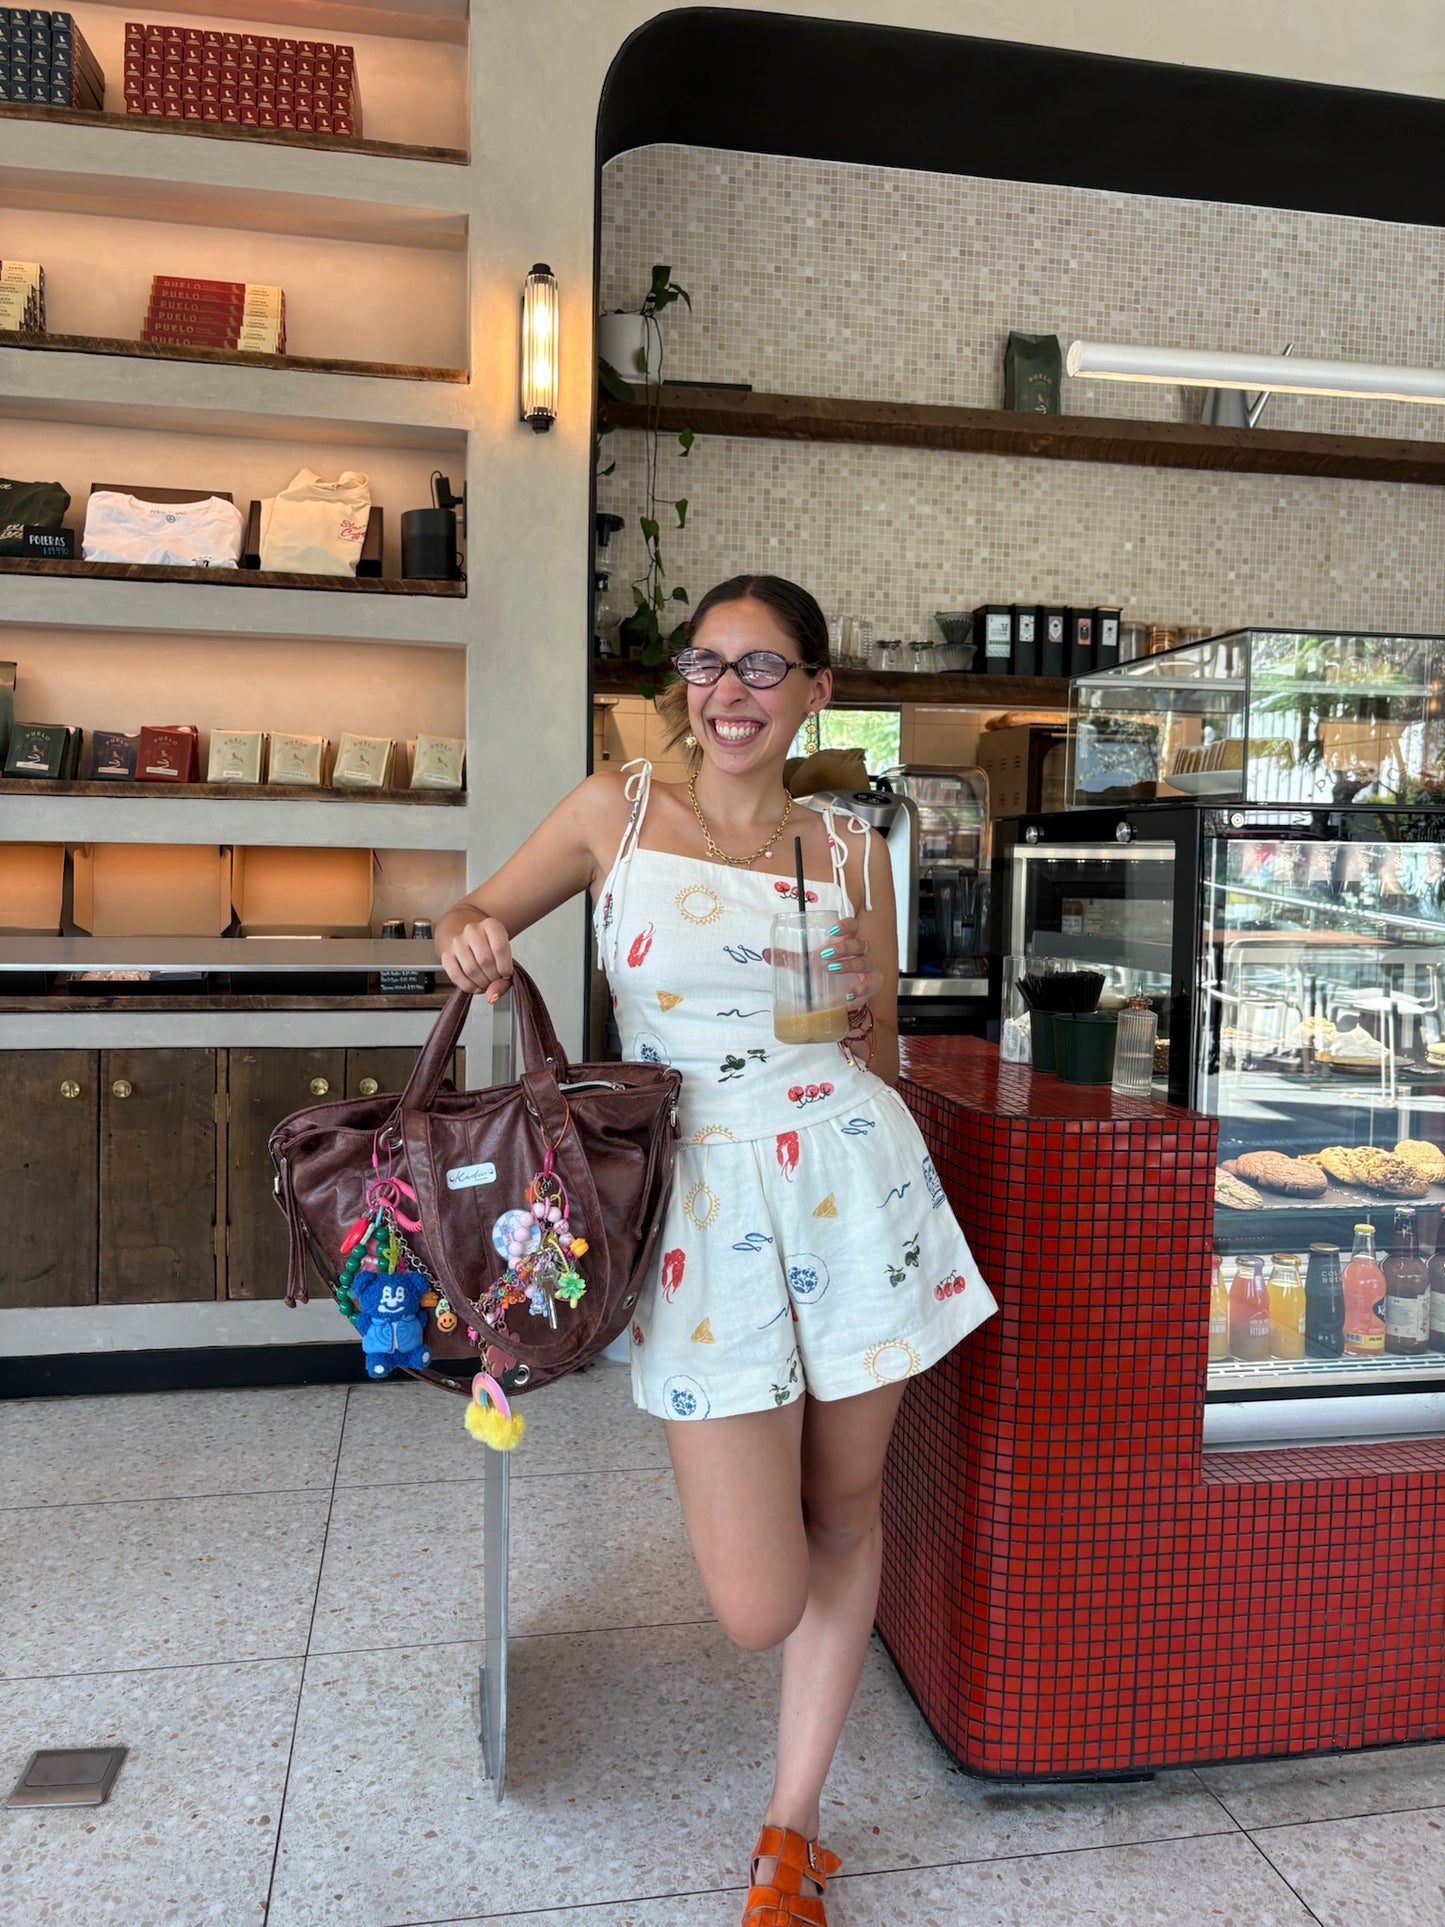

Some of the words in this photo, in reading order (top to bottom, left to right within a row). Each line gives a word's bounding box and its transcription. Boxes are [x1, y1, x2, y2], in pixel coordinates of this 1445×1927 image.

[161, 289, 200, 301] PUELO
[160, 300, 199, 311] PUELO
[158, 311, 197, 322] PUELO
[154, 322, 194, 334] PUELO
[29, 534, 66, 547] POLERAS
[25, 730, 51, 742] PUELO
[153, 735, 179, 746] PUELO
